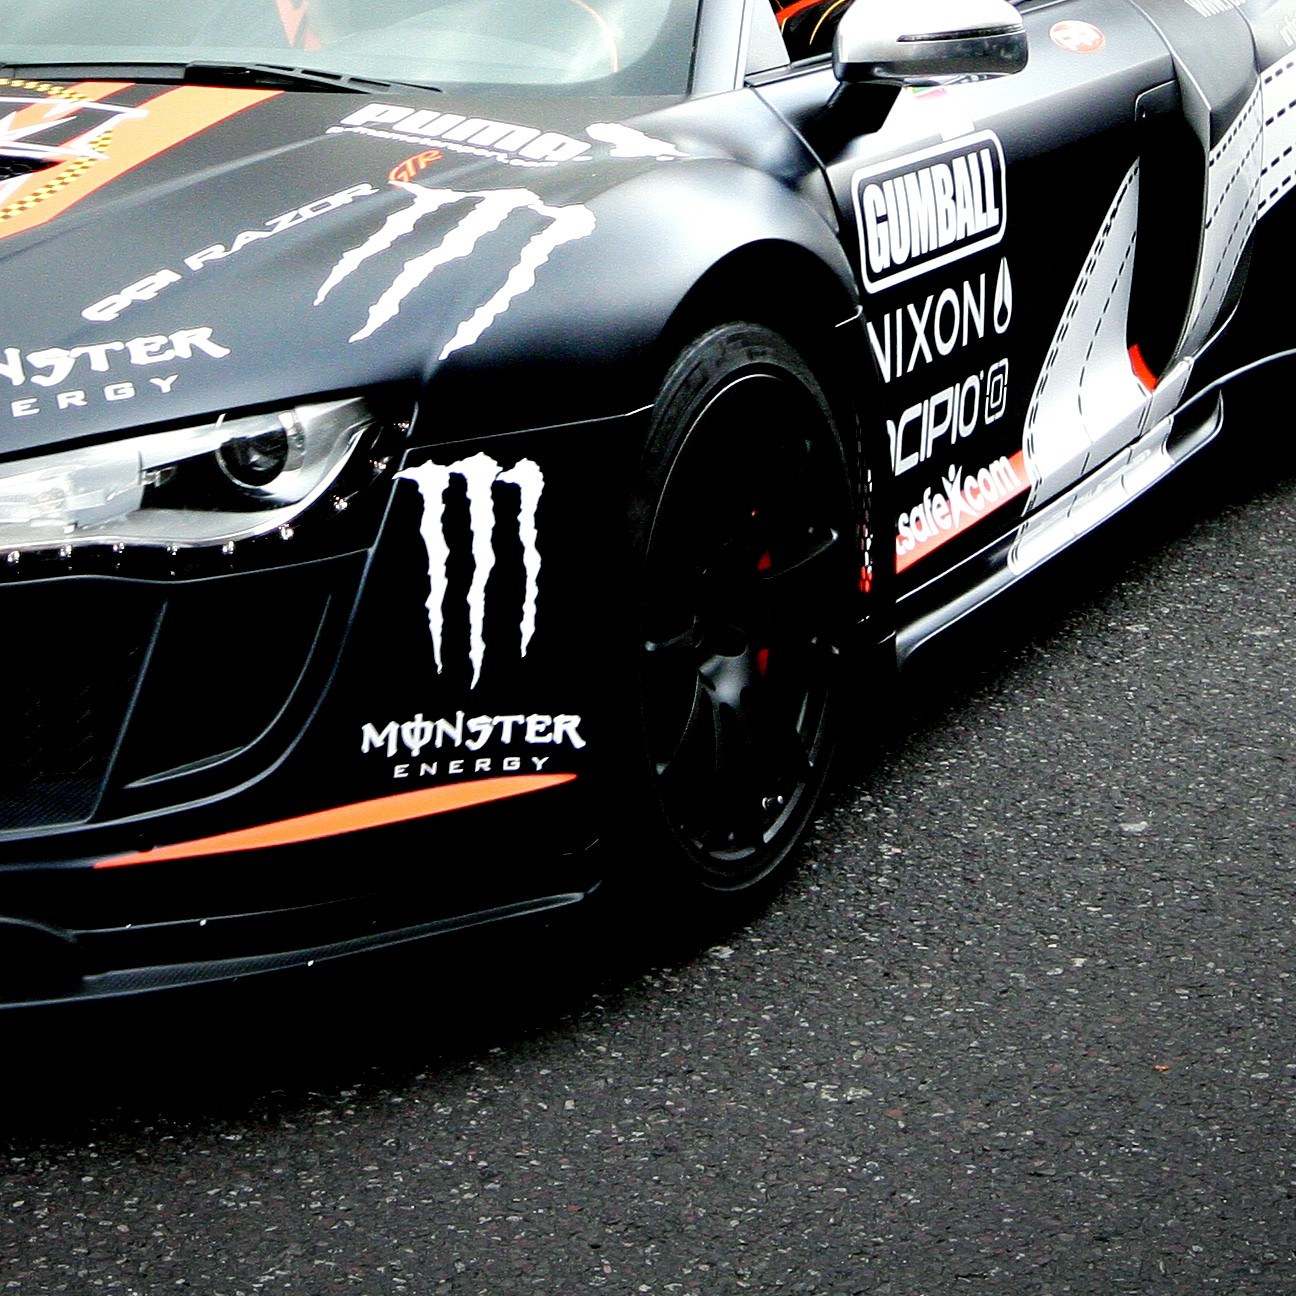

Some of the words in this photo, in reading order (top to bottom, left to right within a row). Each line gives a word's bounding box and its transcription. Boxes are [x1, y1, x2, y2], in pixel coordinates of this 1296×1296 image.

[340, 102, 592, 162] PUMA
[184, 182, 380, 271] RAZOR
[861, 147, 1000, 275] GUMBALL
[360, 710, 587, 757] MONSTER
[392, 756, 550, 779] ENERGY
